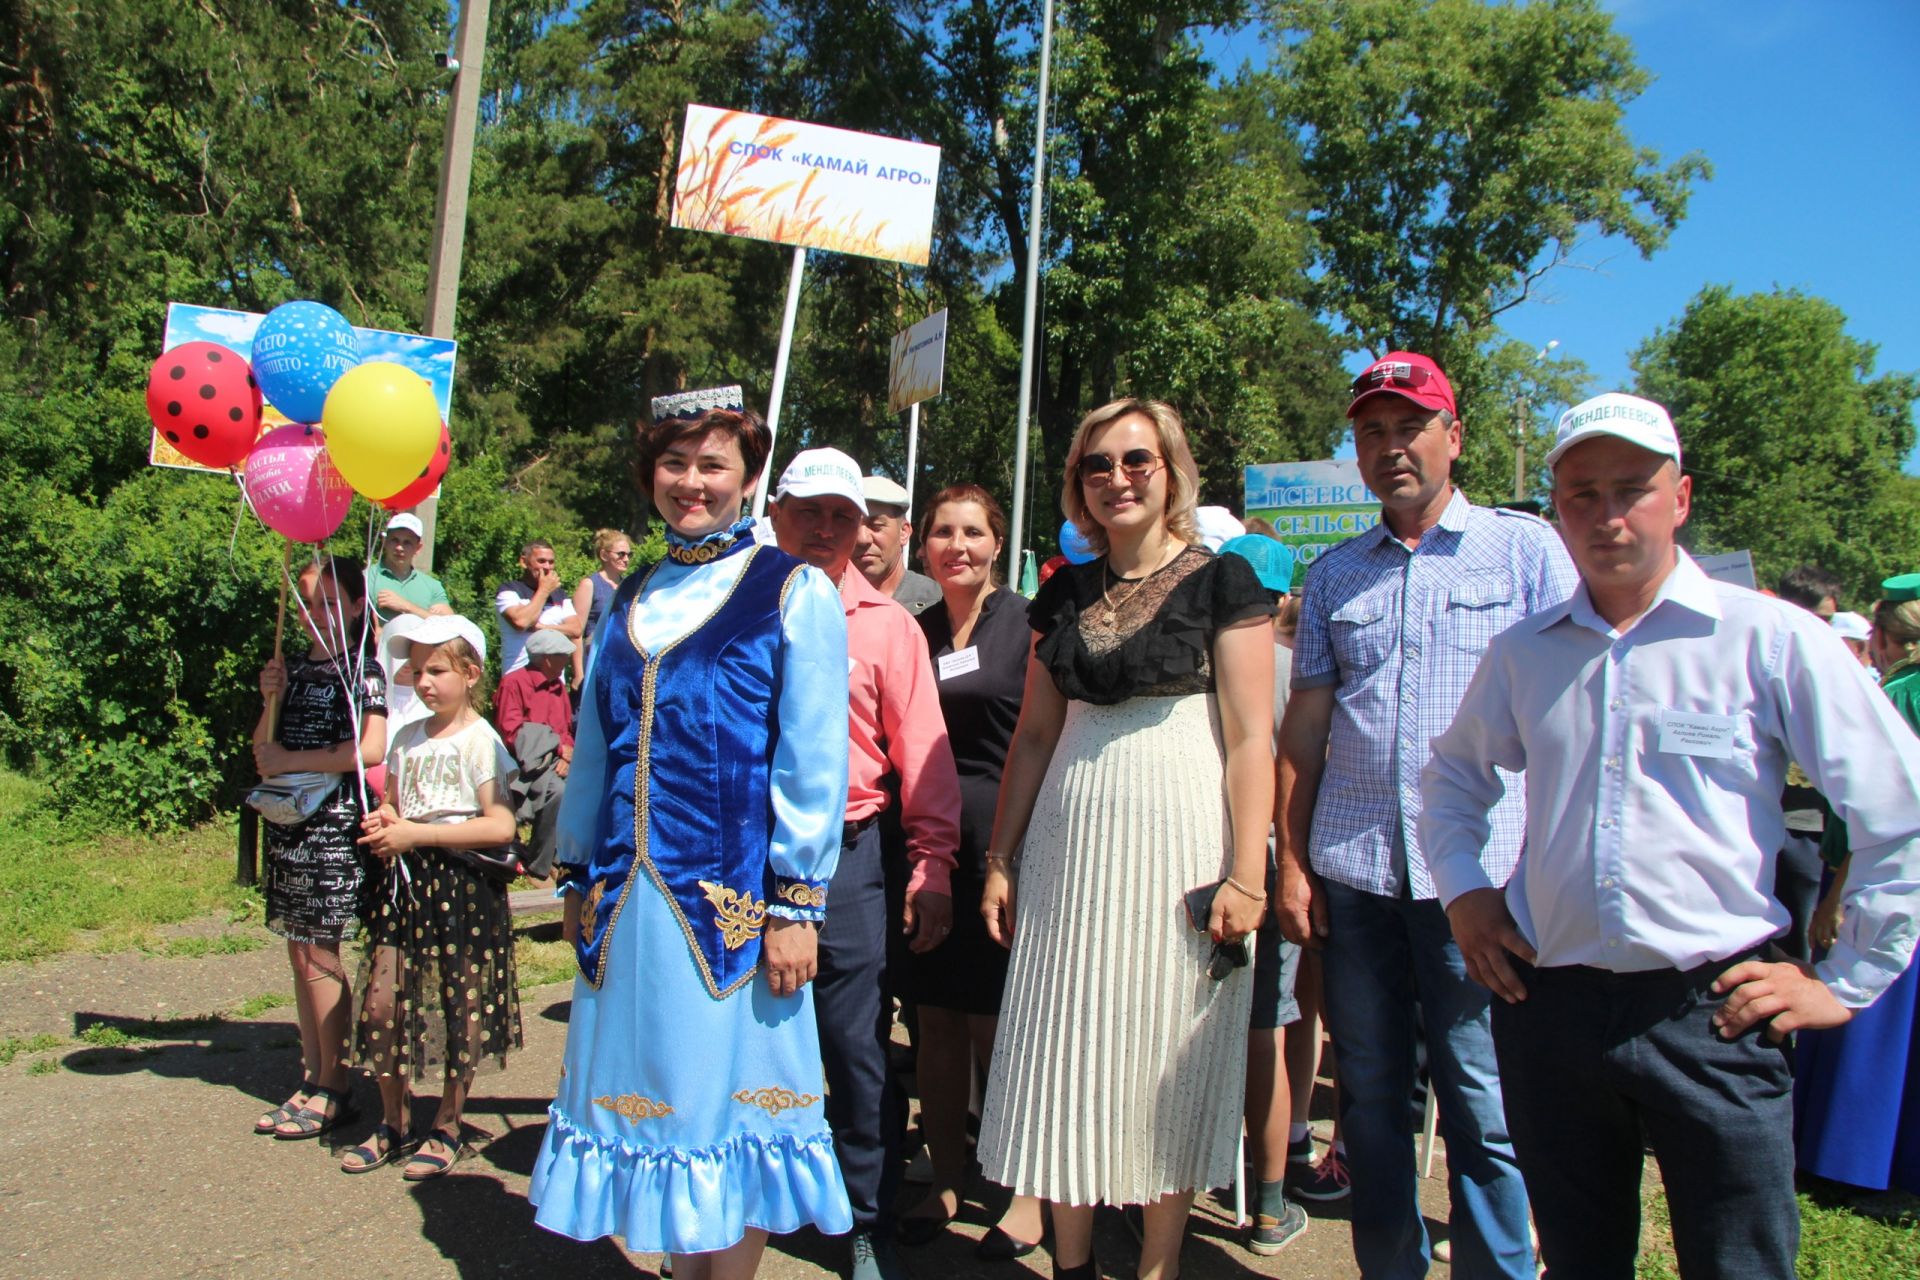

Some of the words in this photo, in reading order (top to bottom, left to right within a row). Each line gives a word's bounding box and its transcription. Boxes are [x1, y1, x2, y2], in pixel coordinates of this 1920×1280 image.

[728, 141, 784, 162] СПОК
[792, 152, 869, 176] «КАМАЙ
[876, 166, 932, 186] АГРО»
[1569, 405, 1659, 432] МЕНДЕЛЕЕВСК
[403, 754, 461, 794] PARIS
